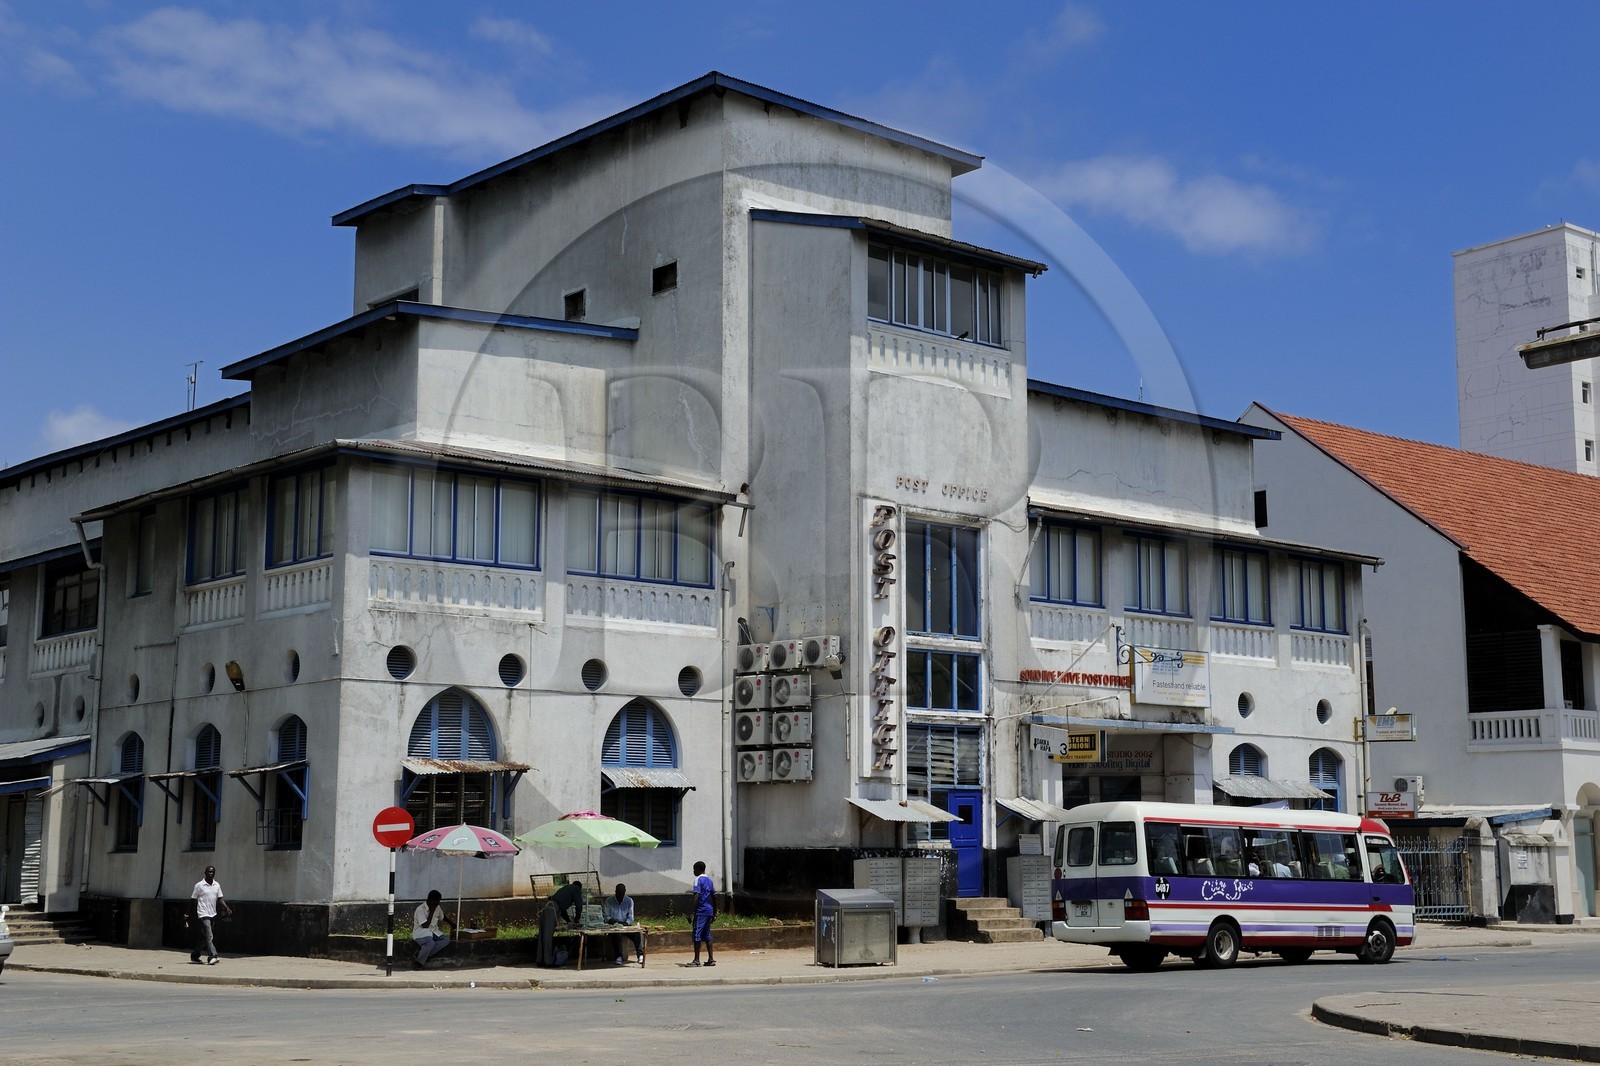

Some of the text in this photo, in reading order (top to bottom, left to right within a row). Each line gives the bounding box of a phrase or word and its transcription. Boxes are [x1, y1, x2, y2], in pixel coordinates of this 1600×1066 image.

[895, 475, 988, 502] POST OFFICE
[871, 504, 897, 771] POST OFFICE
[1081, 673, 1102, 685] POST
[1185, 682, 1207, 691] reliable
[1377, 716, 1395, 726] EMS
[1059, 743, 1067, 756] 3
[1125, 759, 1151, 771] Digital
[1201, 879, 1227, 901] City
